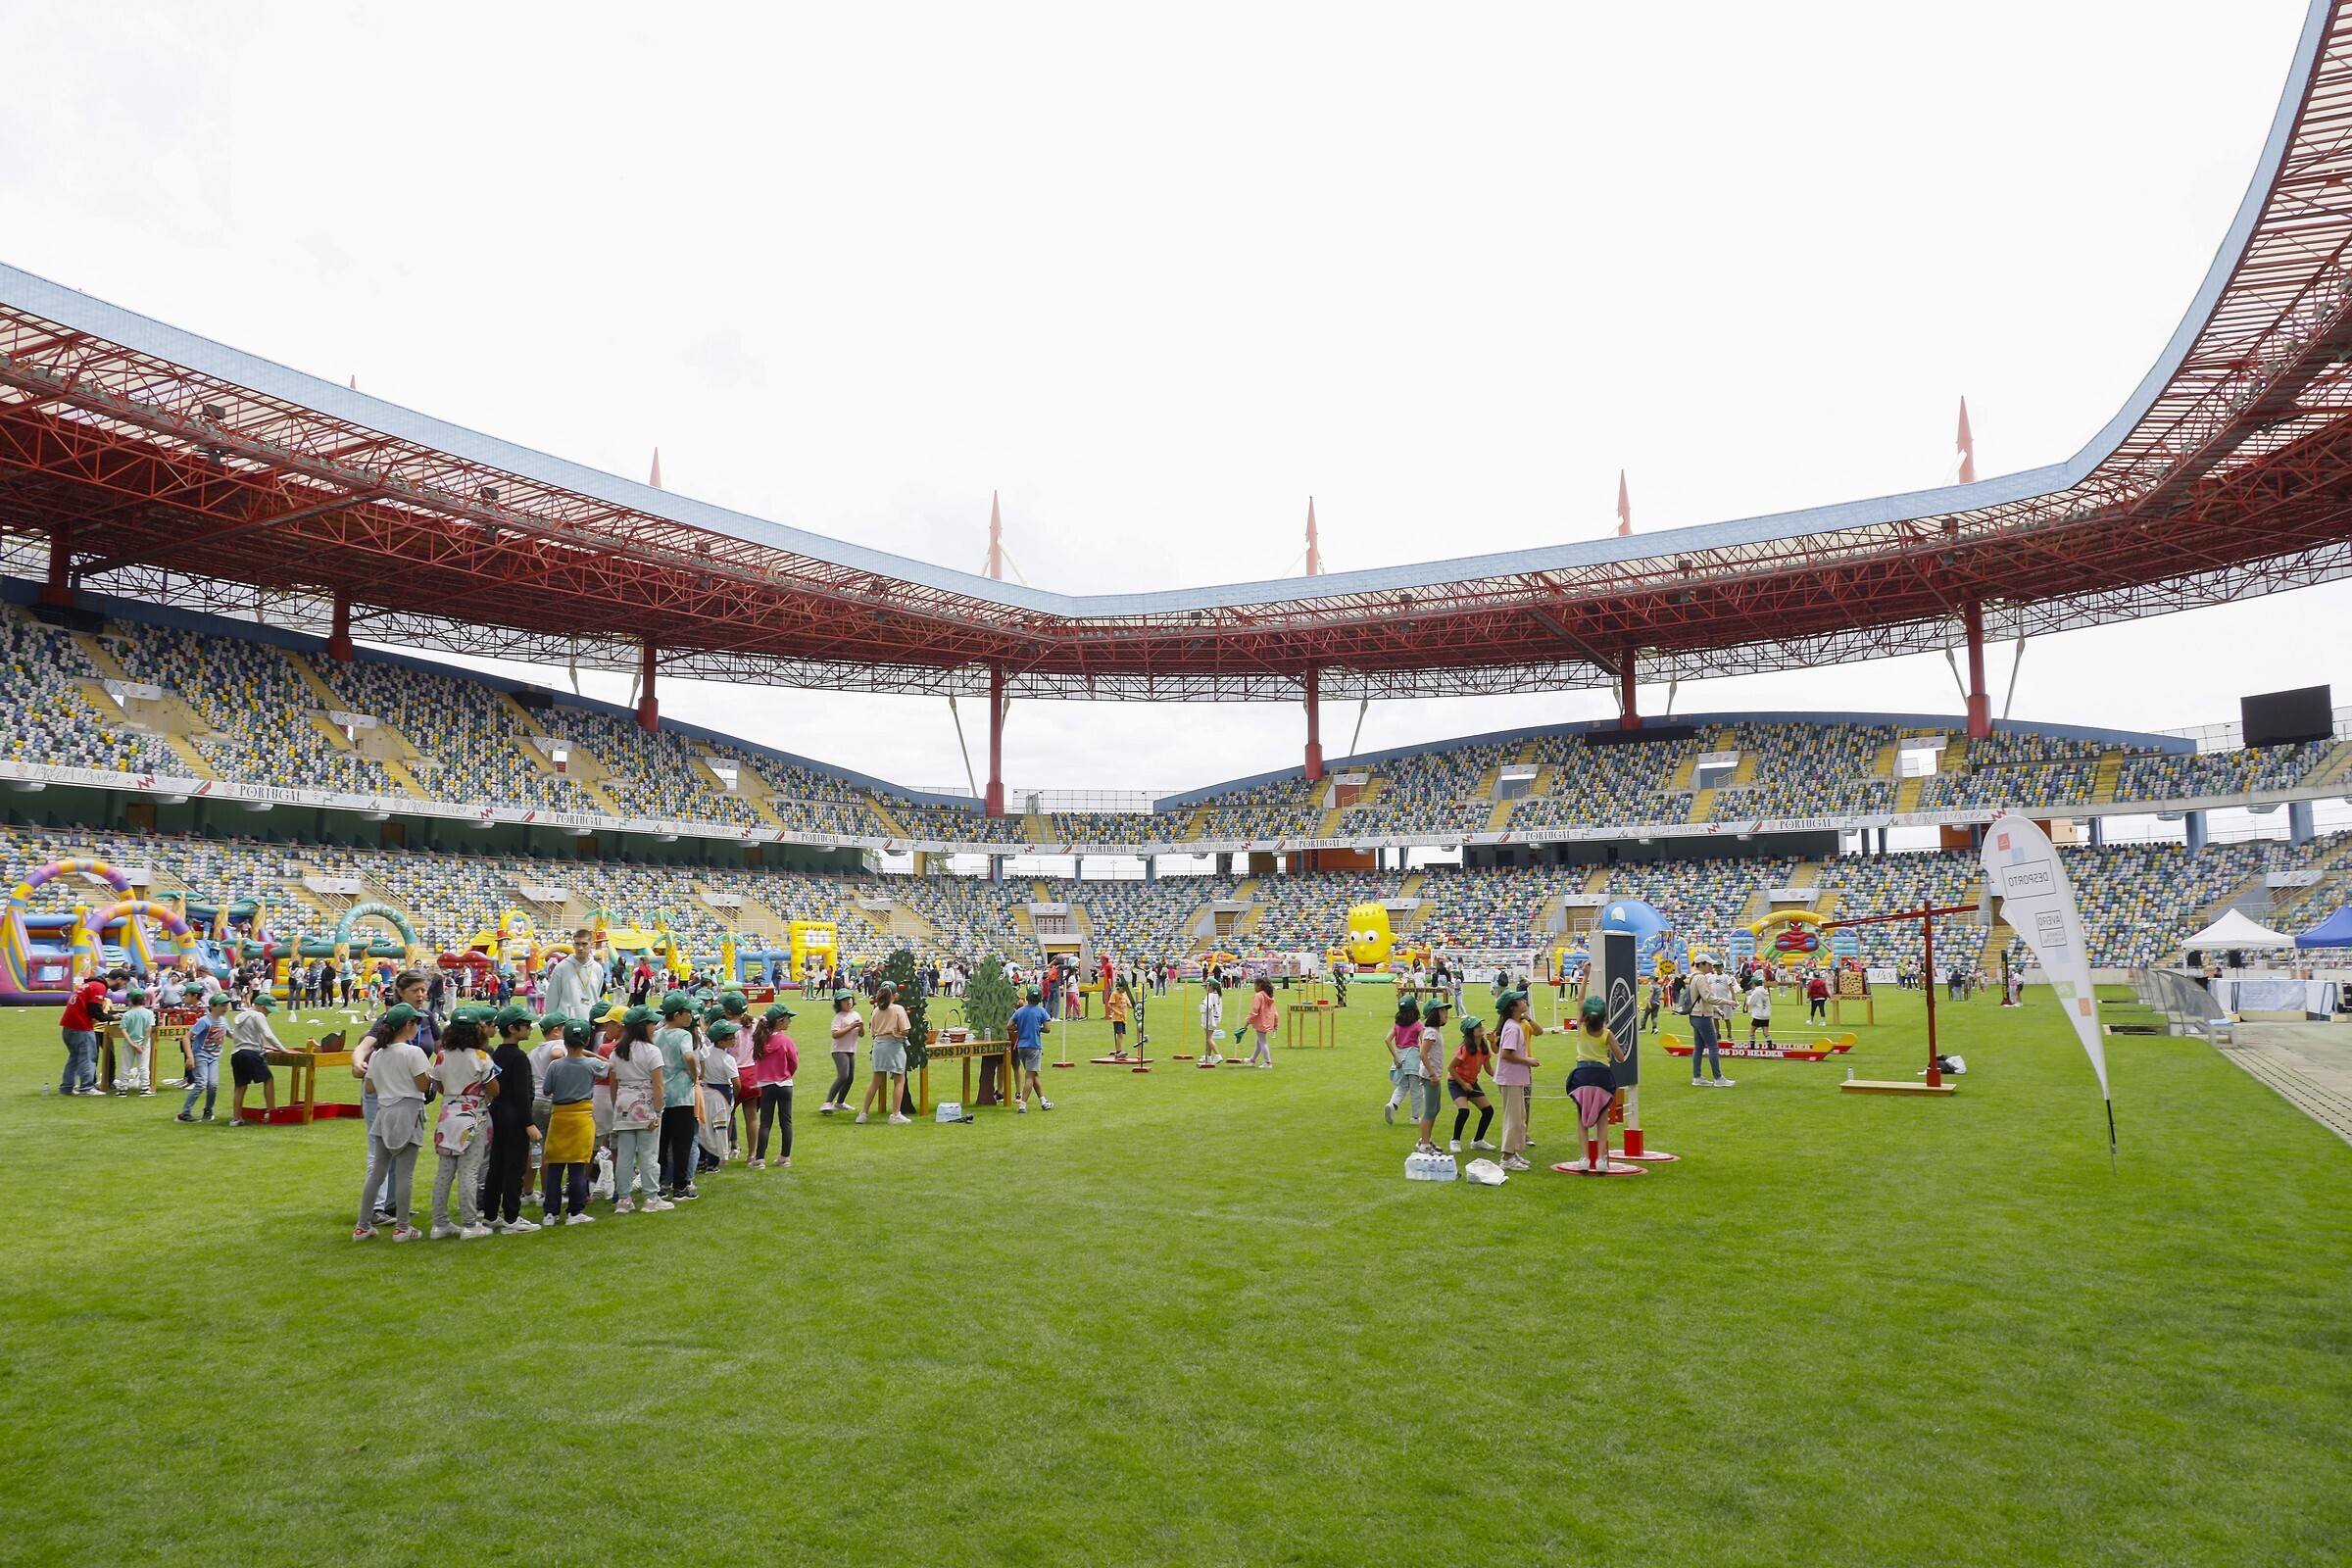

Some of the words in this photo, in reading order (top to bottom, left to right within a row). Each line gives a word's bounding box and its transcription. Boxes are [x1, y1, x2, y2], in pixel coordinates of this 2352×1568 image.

[240, 785, 302, 803] PORTUGAL
[556, 813, 602, 826] PORTUGAL
[1780, 818, 1832, 830] PORTUGAL
[801, 833, 839, 844] PORTUGAL
[1525, 830, 1570, 841] PORTUGAL
[1298, 839, 1340, 849] PORTUGAL
[159, 1027, 190, 1037] HELD
[926, 1047, 955, 1058] OGOS
[956, 1045, 970, 1055] DO
